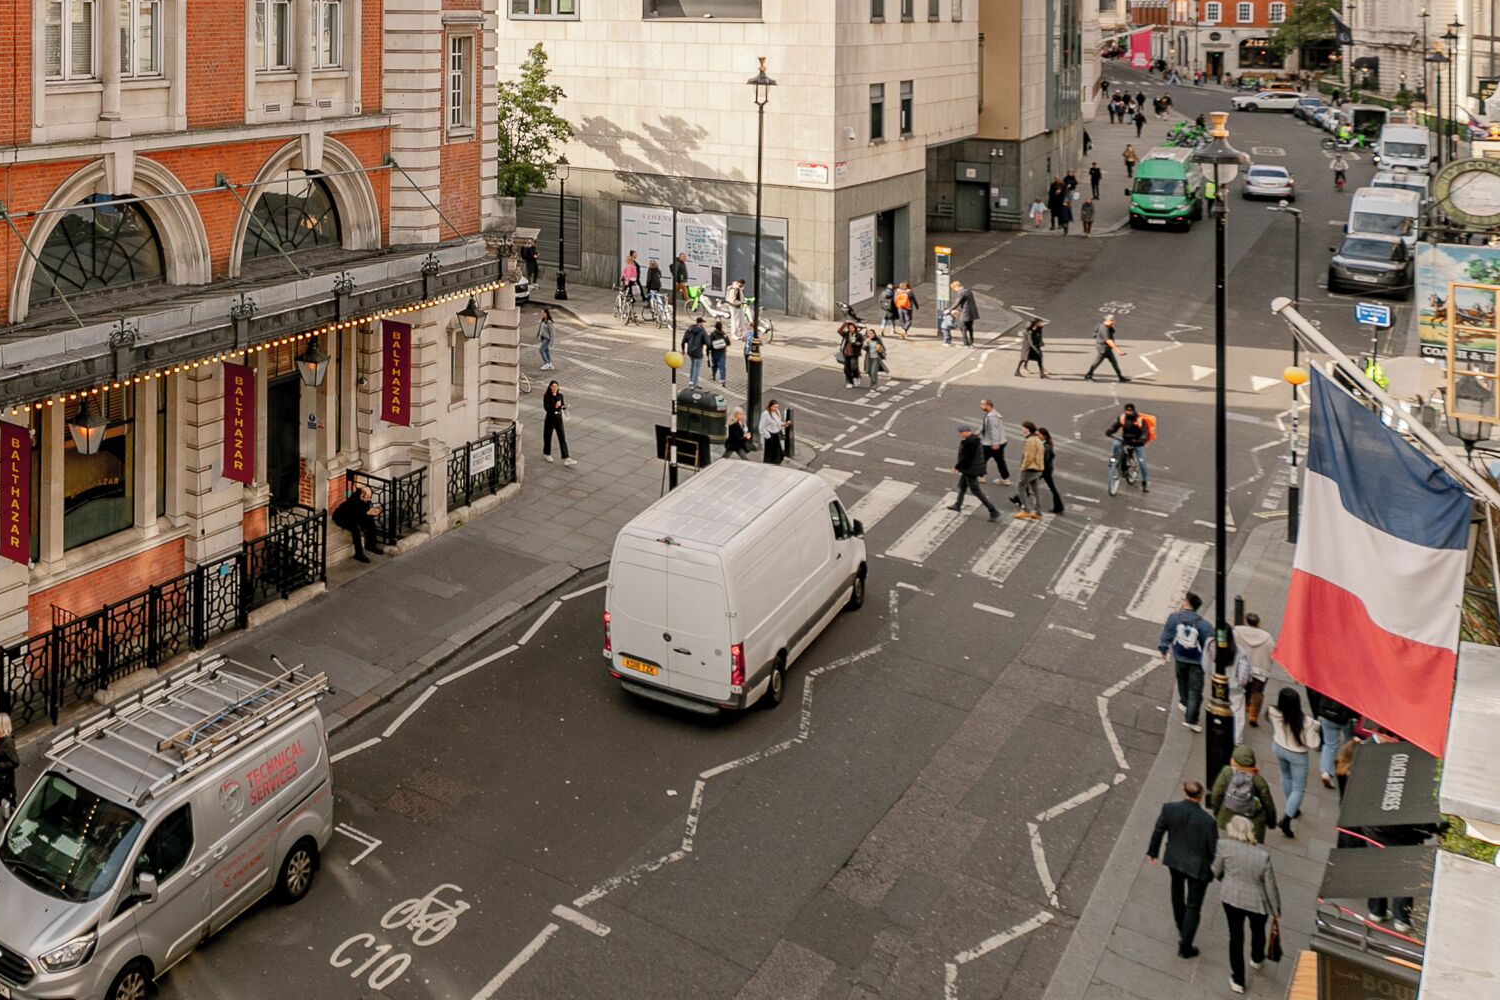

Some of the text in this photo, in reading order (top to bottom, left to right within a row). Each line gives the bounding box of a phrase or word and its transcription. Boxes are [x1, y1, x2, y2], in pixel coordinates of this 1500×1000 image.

[392, 331, 401, 415] BALTHAZAR
[234, 376, 244, 471] BALTHAZAR
[11, 437, 20, 549] BALTHAZAR
[245, 741, 305, 788] TECHNICAL
[250, 762, 298, 807] SERVICES
[330, 933, 412, 990] C10
